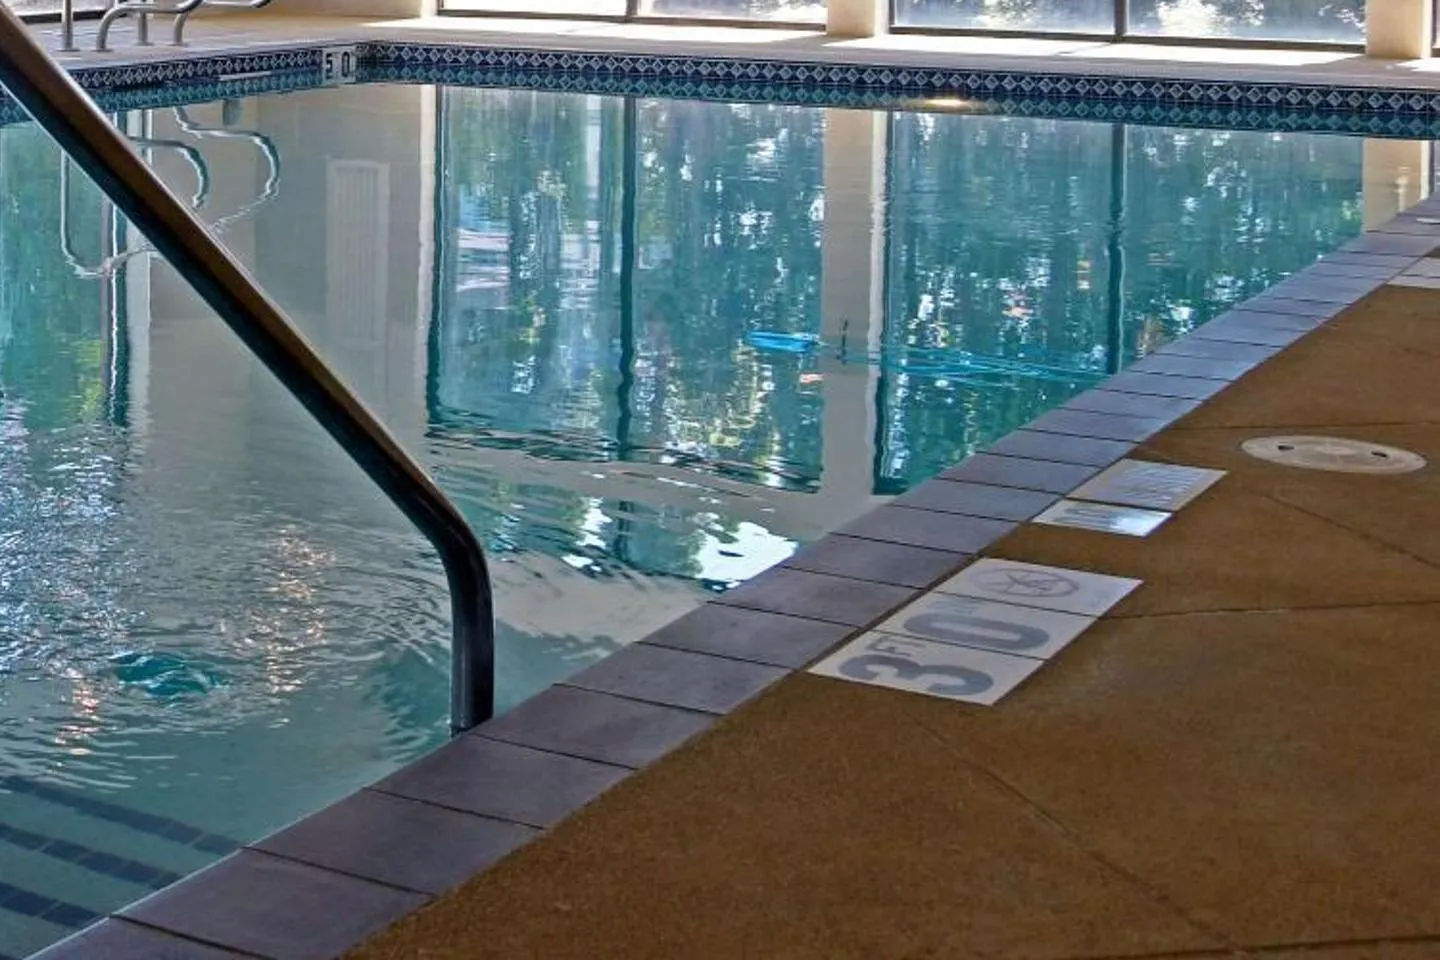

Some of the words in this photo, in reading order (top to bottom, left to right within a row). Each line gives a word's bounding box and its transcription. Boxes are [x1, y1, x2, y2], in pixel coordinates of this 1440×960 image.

[864, 634, 927, 657] FT
[903, 612, 1051, 651] 0
[838, 654, 995, 696] 3
